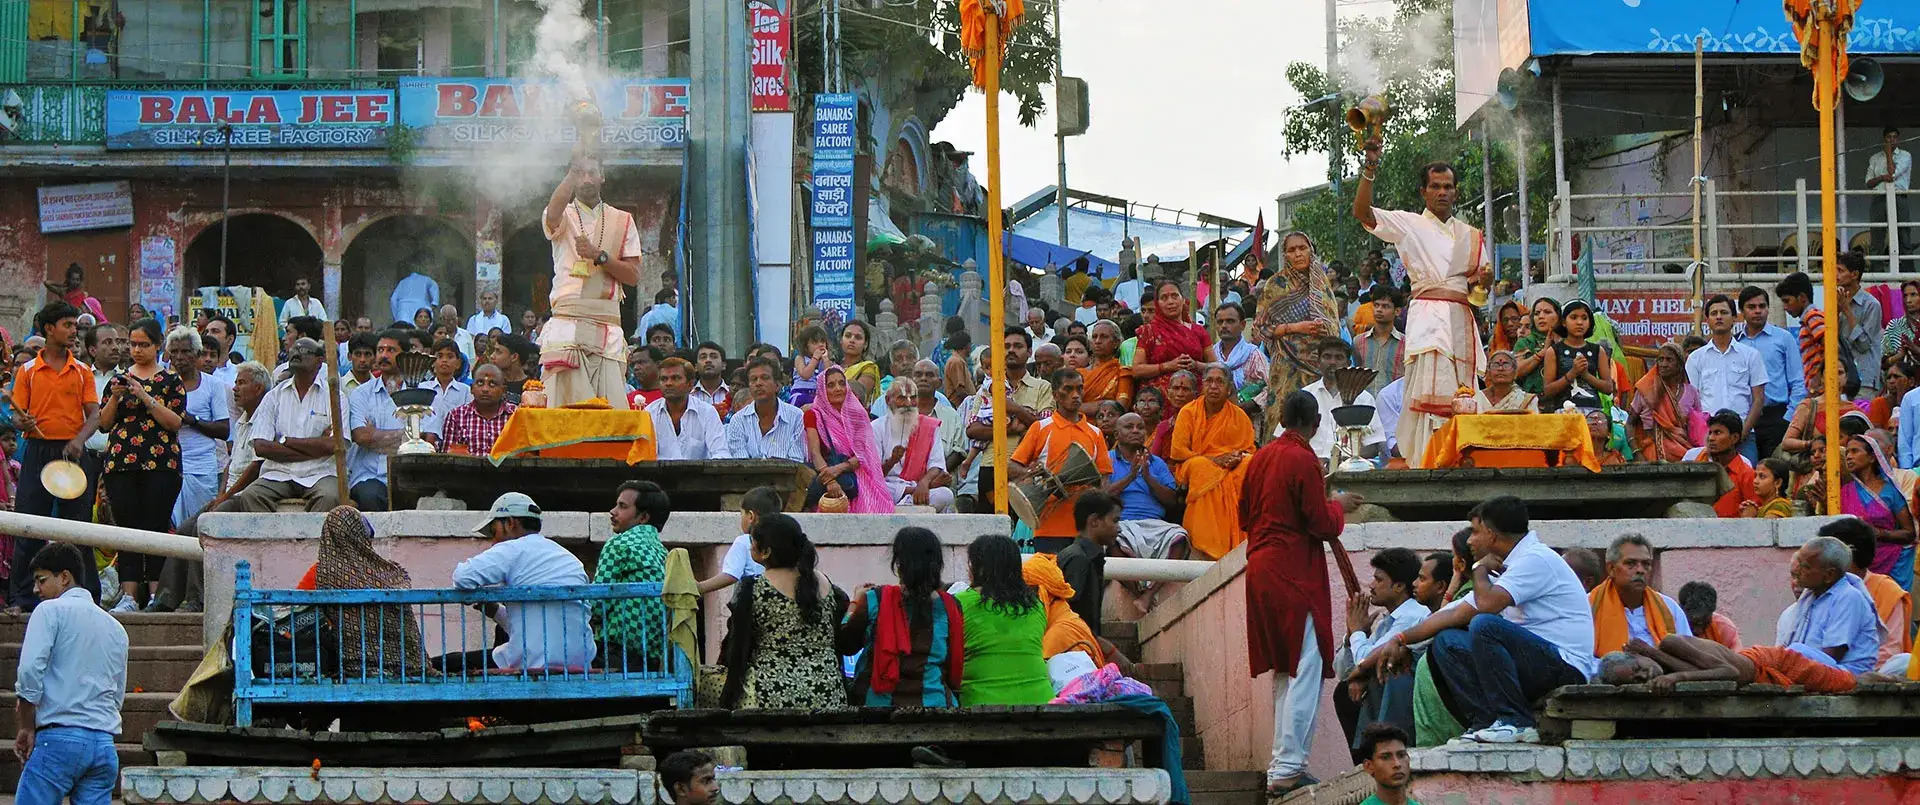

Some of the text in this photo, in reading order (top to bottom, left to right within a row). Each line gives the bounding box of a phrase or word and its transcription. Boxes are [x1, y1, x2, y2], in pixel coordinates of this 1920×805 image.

[752, 39, 783, 66] Silk
[138, 95, 389, 125] BALA JEE
[816, 107, 853, 121] BANARAS
[454, 124, 508, 143] SILK
[821, 123, 848, 134] SAREE
[155, 128, 373, 144] SILK SAREE FACTORY
[816, 136, 852, 148] FACTORY
[815, 175, 851, 187] बनारस
[815, 230, 853, 245] BANARAS
[821, 246, 848, 258] SAREE
[815, 259, 853, 271] FACTORY
[1595, 299, 1634, 314] MAY
[1637, 299, 1646, 314] I
